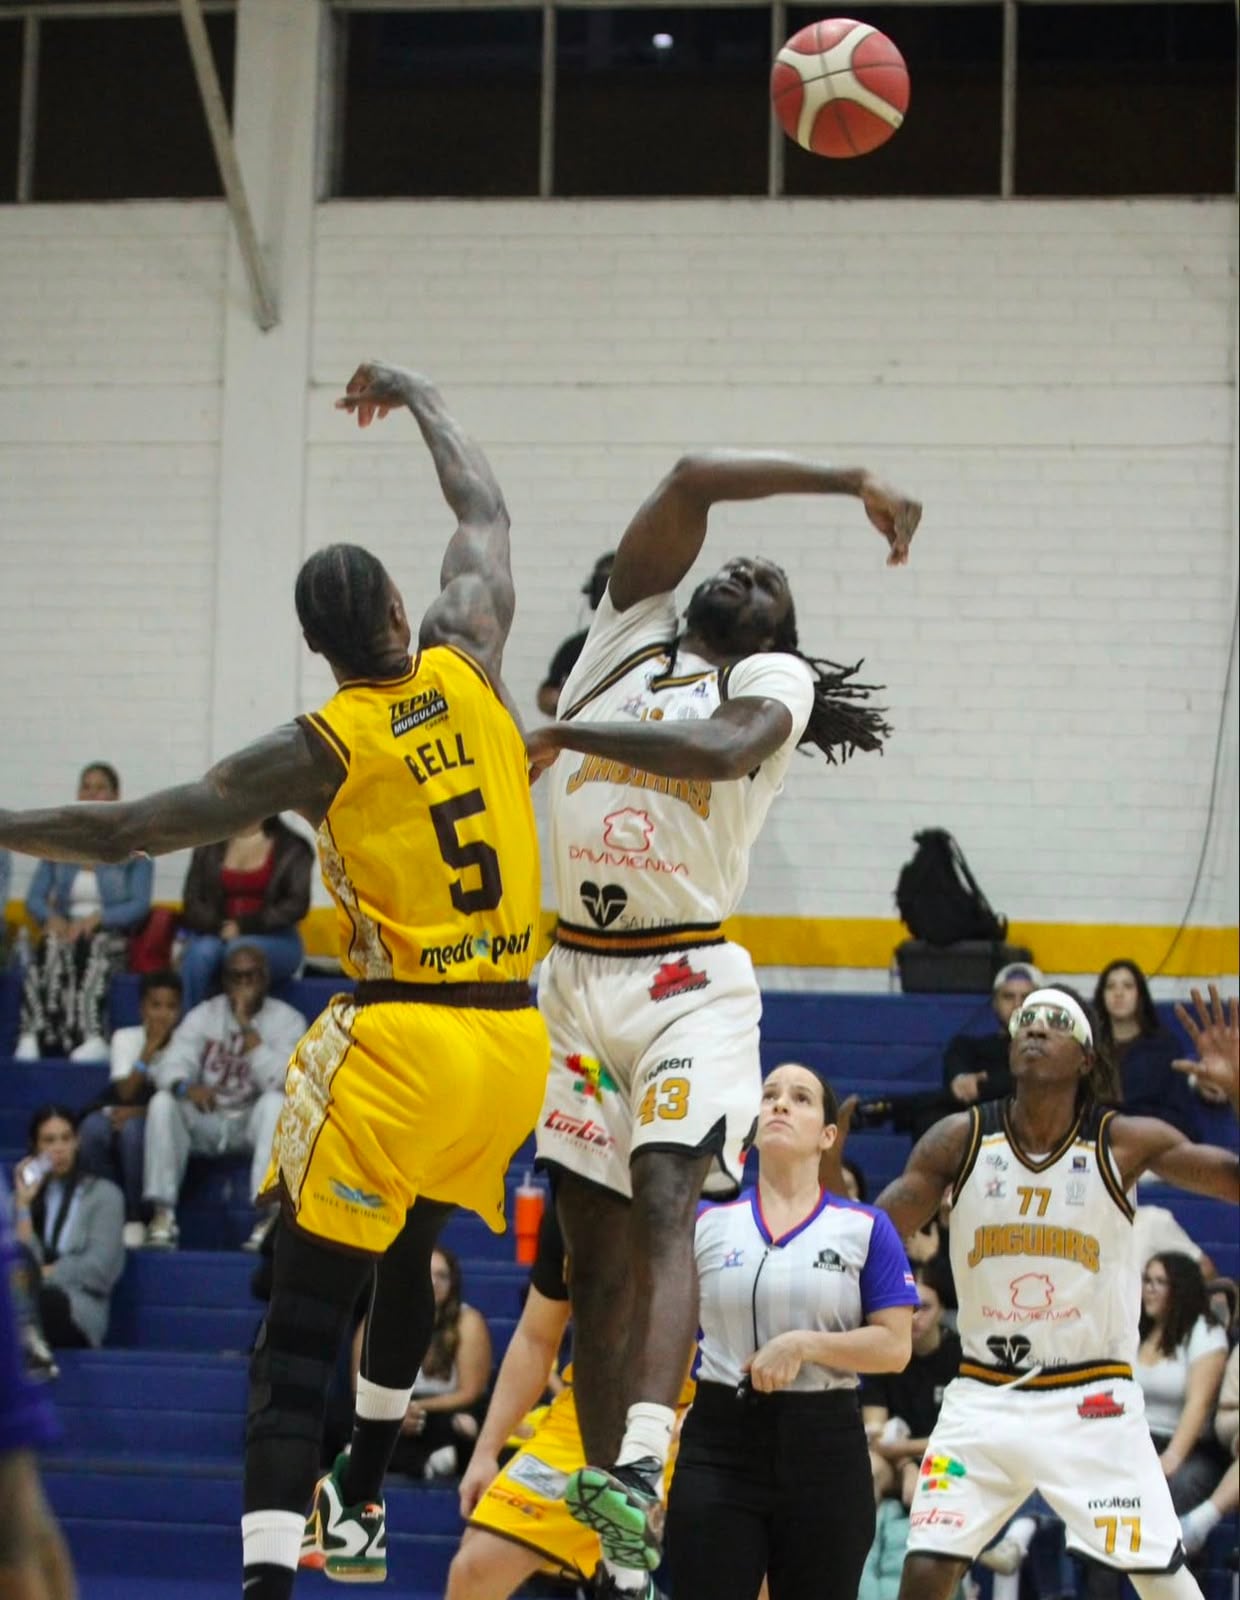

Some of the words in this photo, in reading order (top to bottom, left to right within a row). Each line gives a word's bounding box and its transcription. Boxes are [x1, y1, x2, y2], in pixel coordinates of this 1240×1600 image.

[394, 698, 445, 735] MUSCULAR
[429, 788, 503, 915] 5
[637, 1077, 691, 1126] 43
[1017, 1185, 1052, 1217] 77
[968, 1222, 1100, 1274] JAGUARS
[1088, 1496, 1141, 1509] molten
[1094, 1515, 1141, 1556] 77
